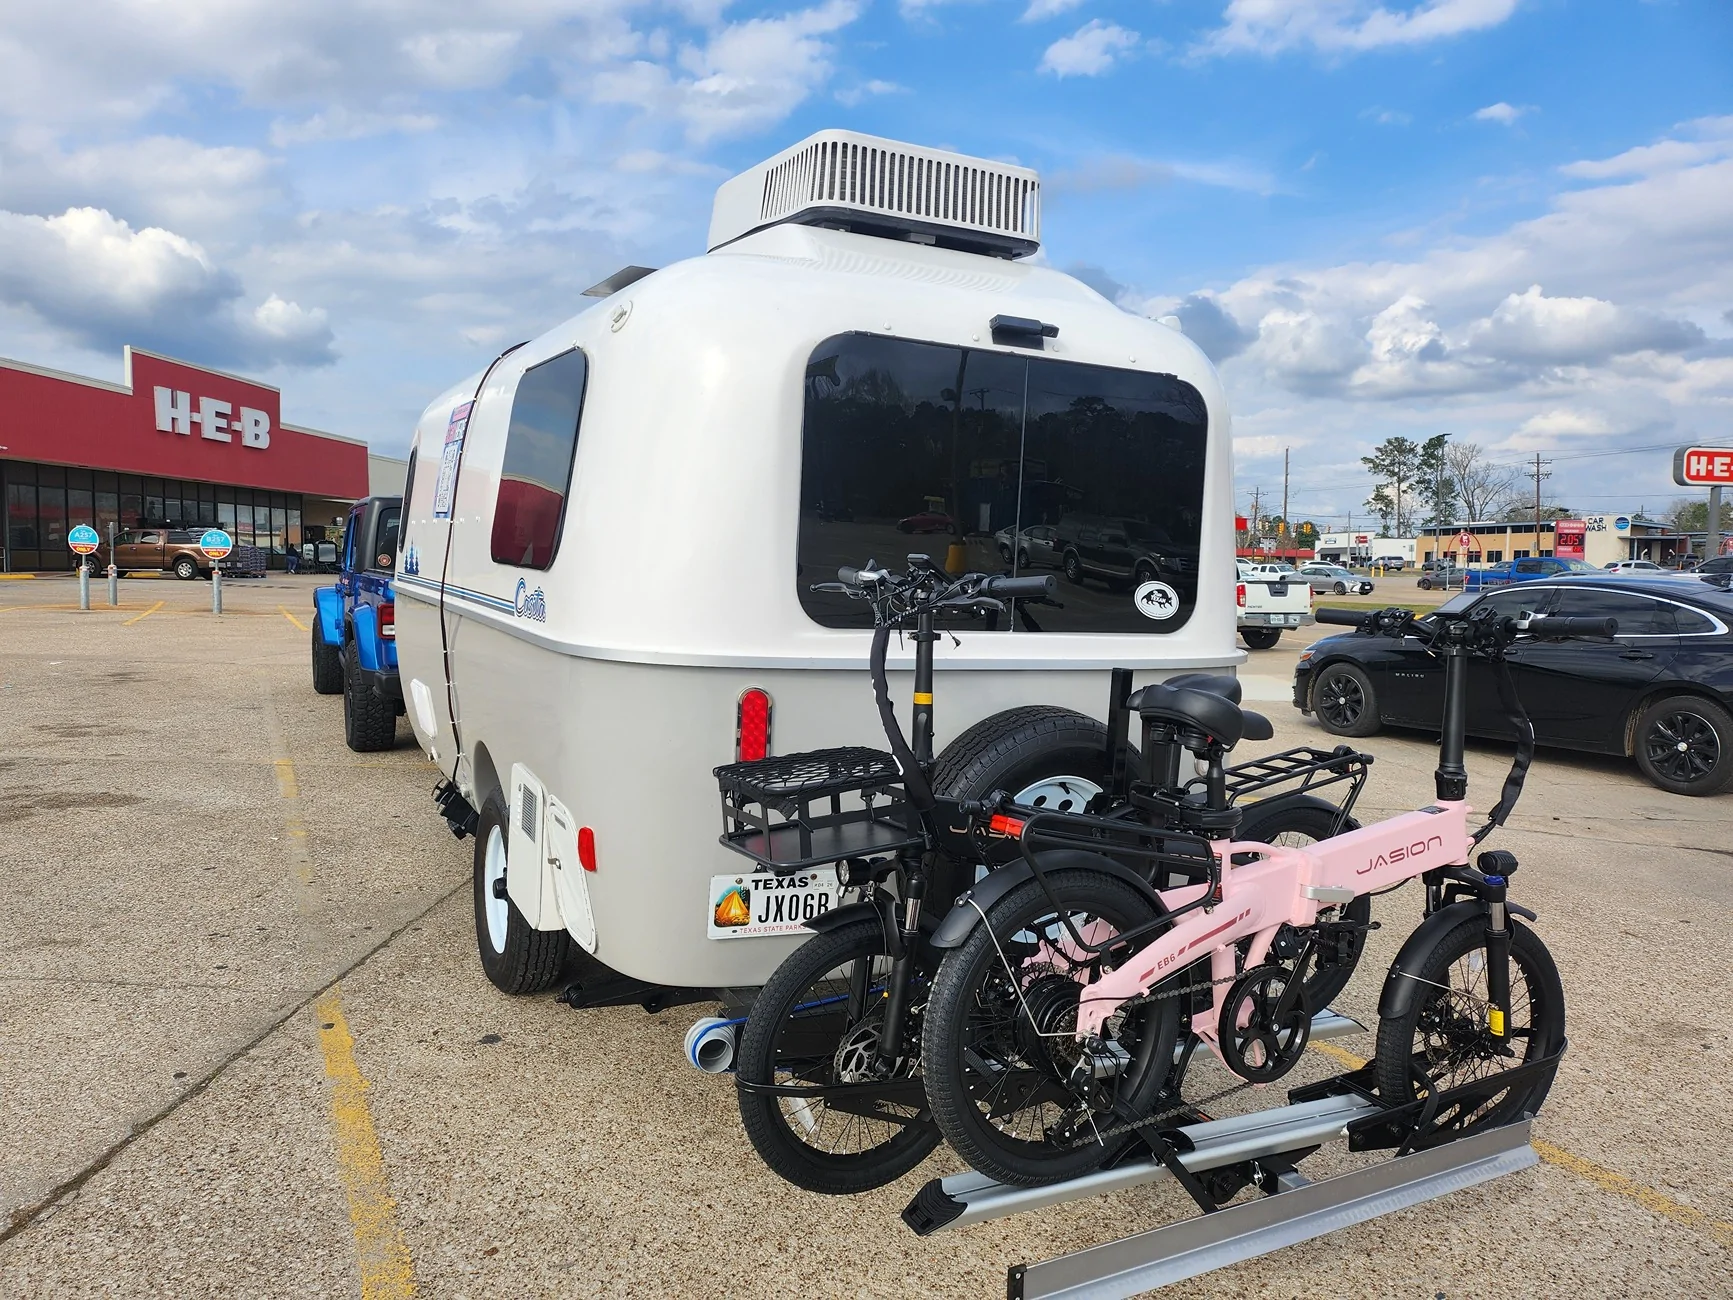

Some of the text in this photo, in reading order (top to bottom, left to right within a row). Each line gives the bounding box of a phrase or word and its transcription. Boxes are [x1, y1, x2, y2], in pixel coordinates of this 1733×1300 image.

[154, 386, 270, 450] H-E-B
[1587, 517, 1604, 525] CAR
[1356, 836, 1442, 875] JASION
[752, 877, 809, 891] TEXAS
[763, 925, 783, 933] STATE
[1157, 953, 1176, 970] EB6
